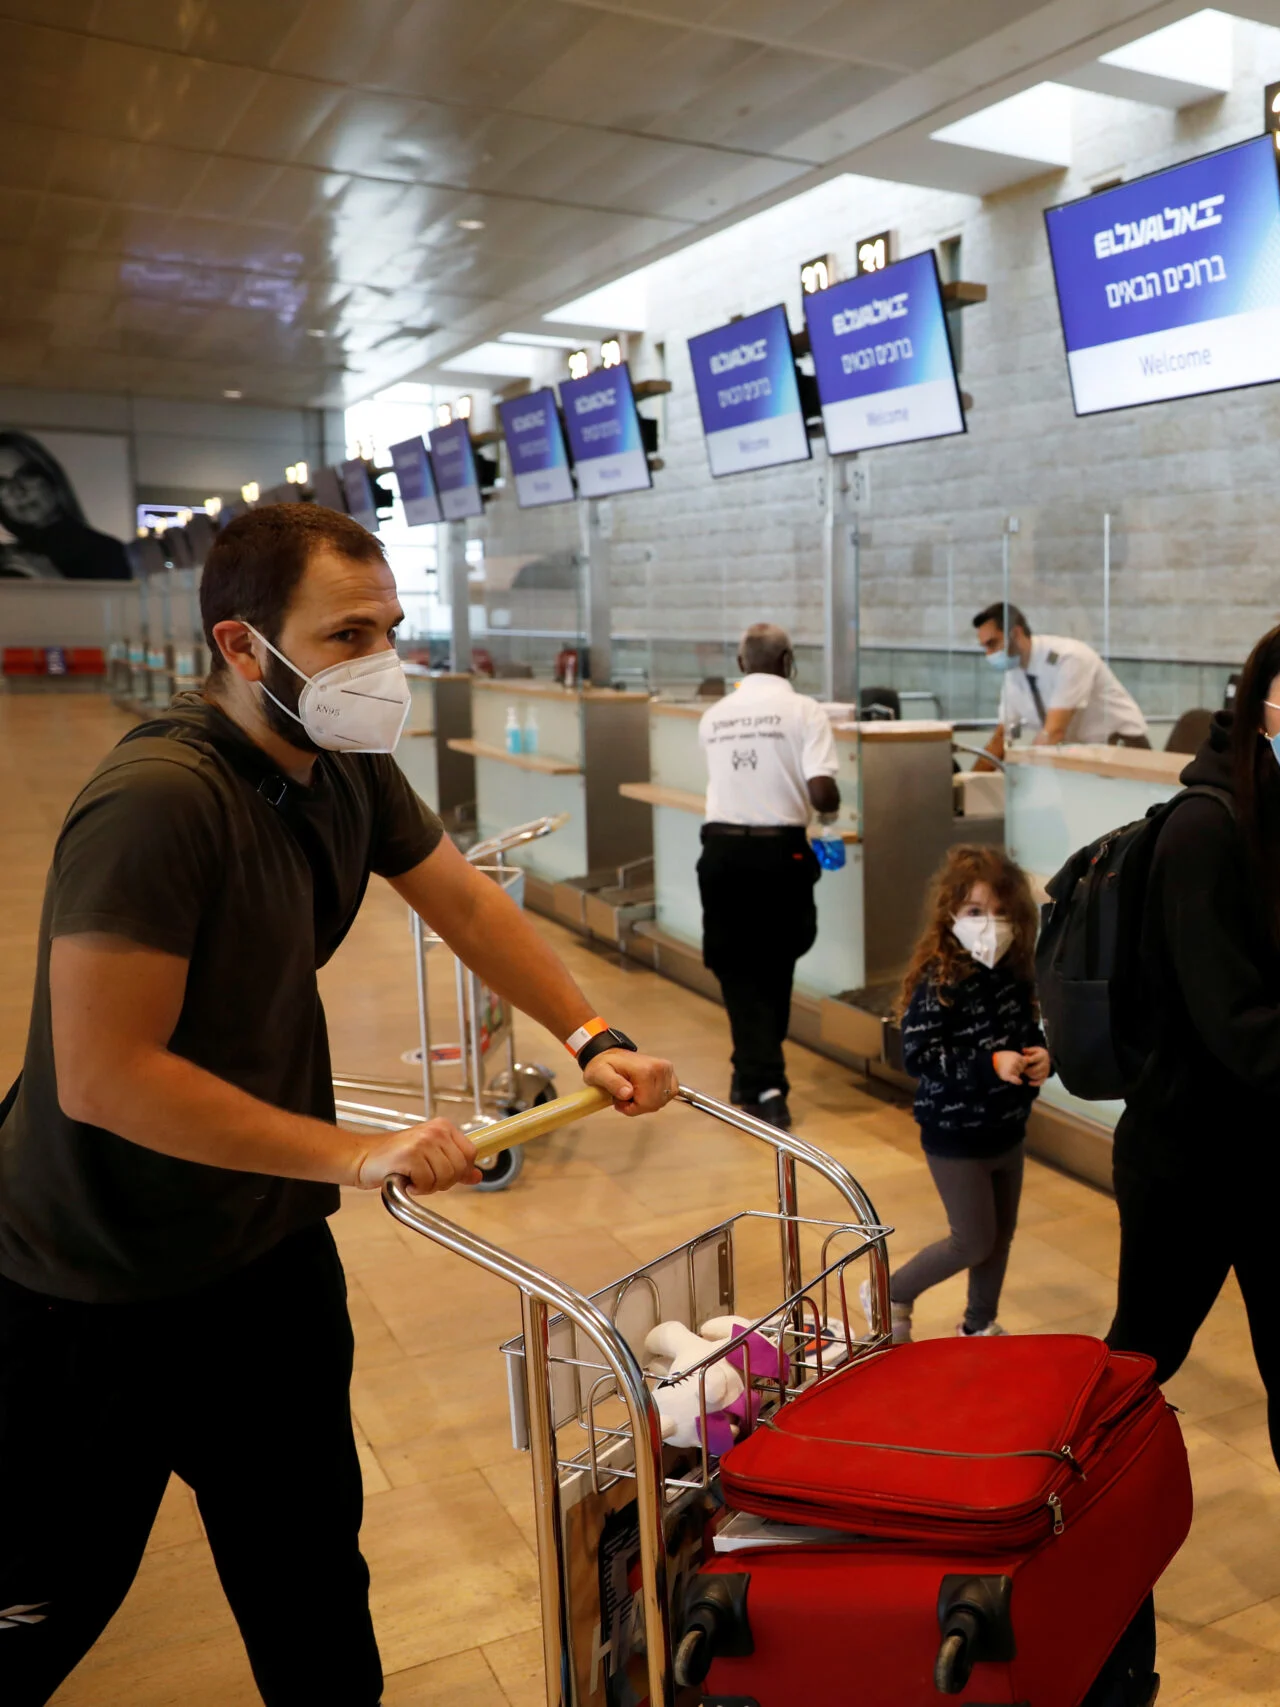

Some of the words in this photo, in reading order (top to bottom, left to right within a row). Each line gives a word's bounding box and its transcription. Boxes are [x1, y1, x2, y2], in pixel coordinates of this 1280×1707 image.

[1105, 272, 1161, 309] הבאים
[1164, 254, 1226, 293] ברוכים
[1138, 345, 1213, 377] Welcome
